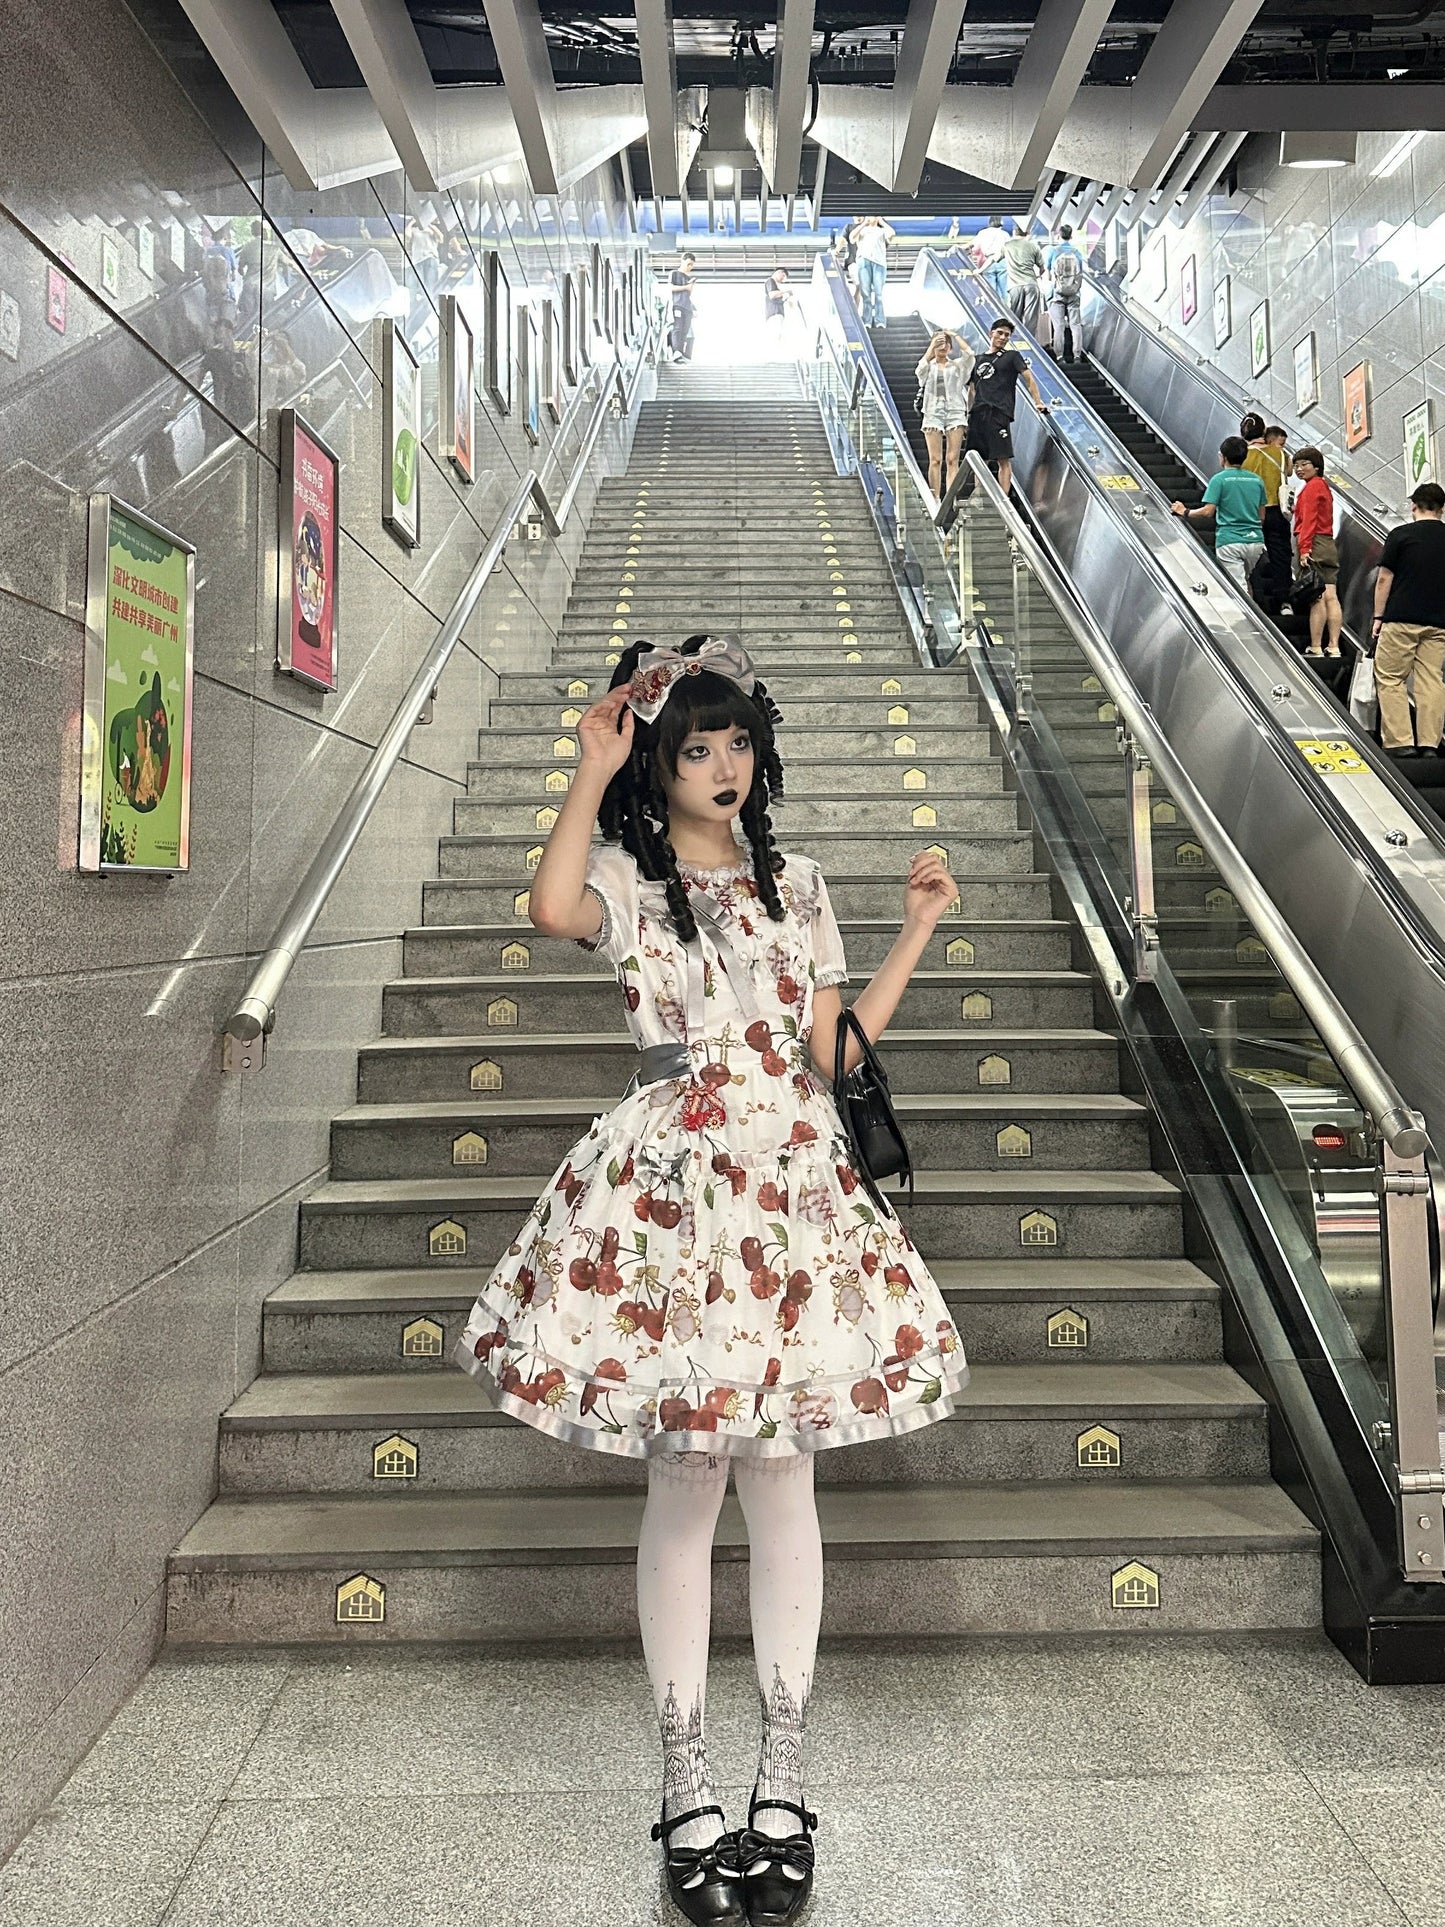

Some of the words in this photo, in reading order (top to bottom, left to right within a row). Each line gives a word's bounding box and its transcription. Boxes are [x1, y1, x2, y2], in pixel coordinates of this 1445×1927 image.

[113, 565, 179, 614] 深化文明城市创建
[112, 597, 179, 643] 共建共享美丽广州
[439, 1234, 457, 1252] 出
[1030, 1225, 1048, 1243] 出
[413, 1333, 432, 1353] 出
[1058, 1324, 1077, 1344] 出
[385, 1453, 407, 1475] 出
[1088, 1442, 1110, 1464] 出
[1124, 1580, 1147, 1604] 出
[349, 1594, 372, 1618] 出
